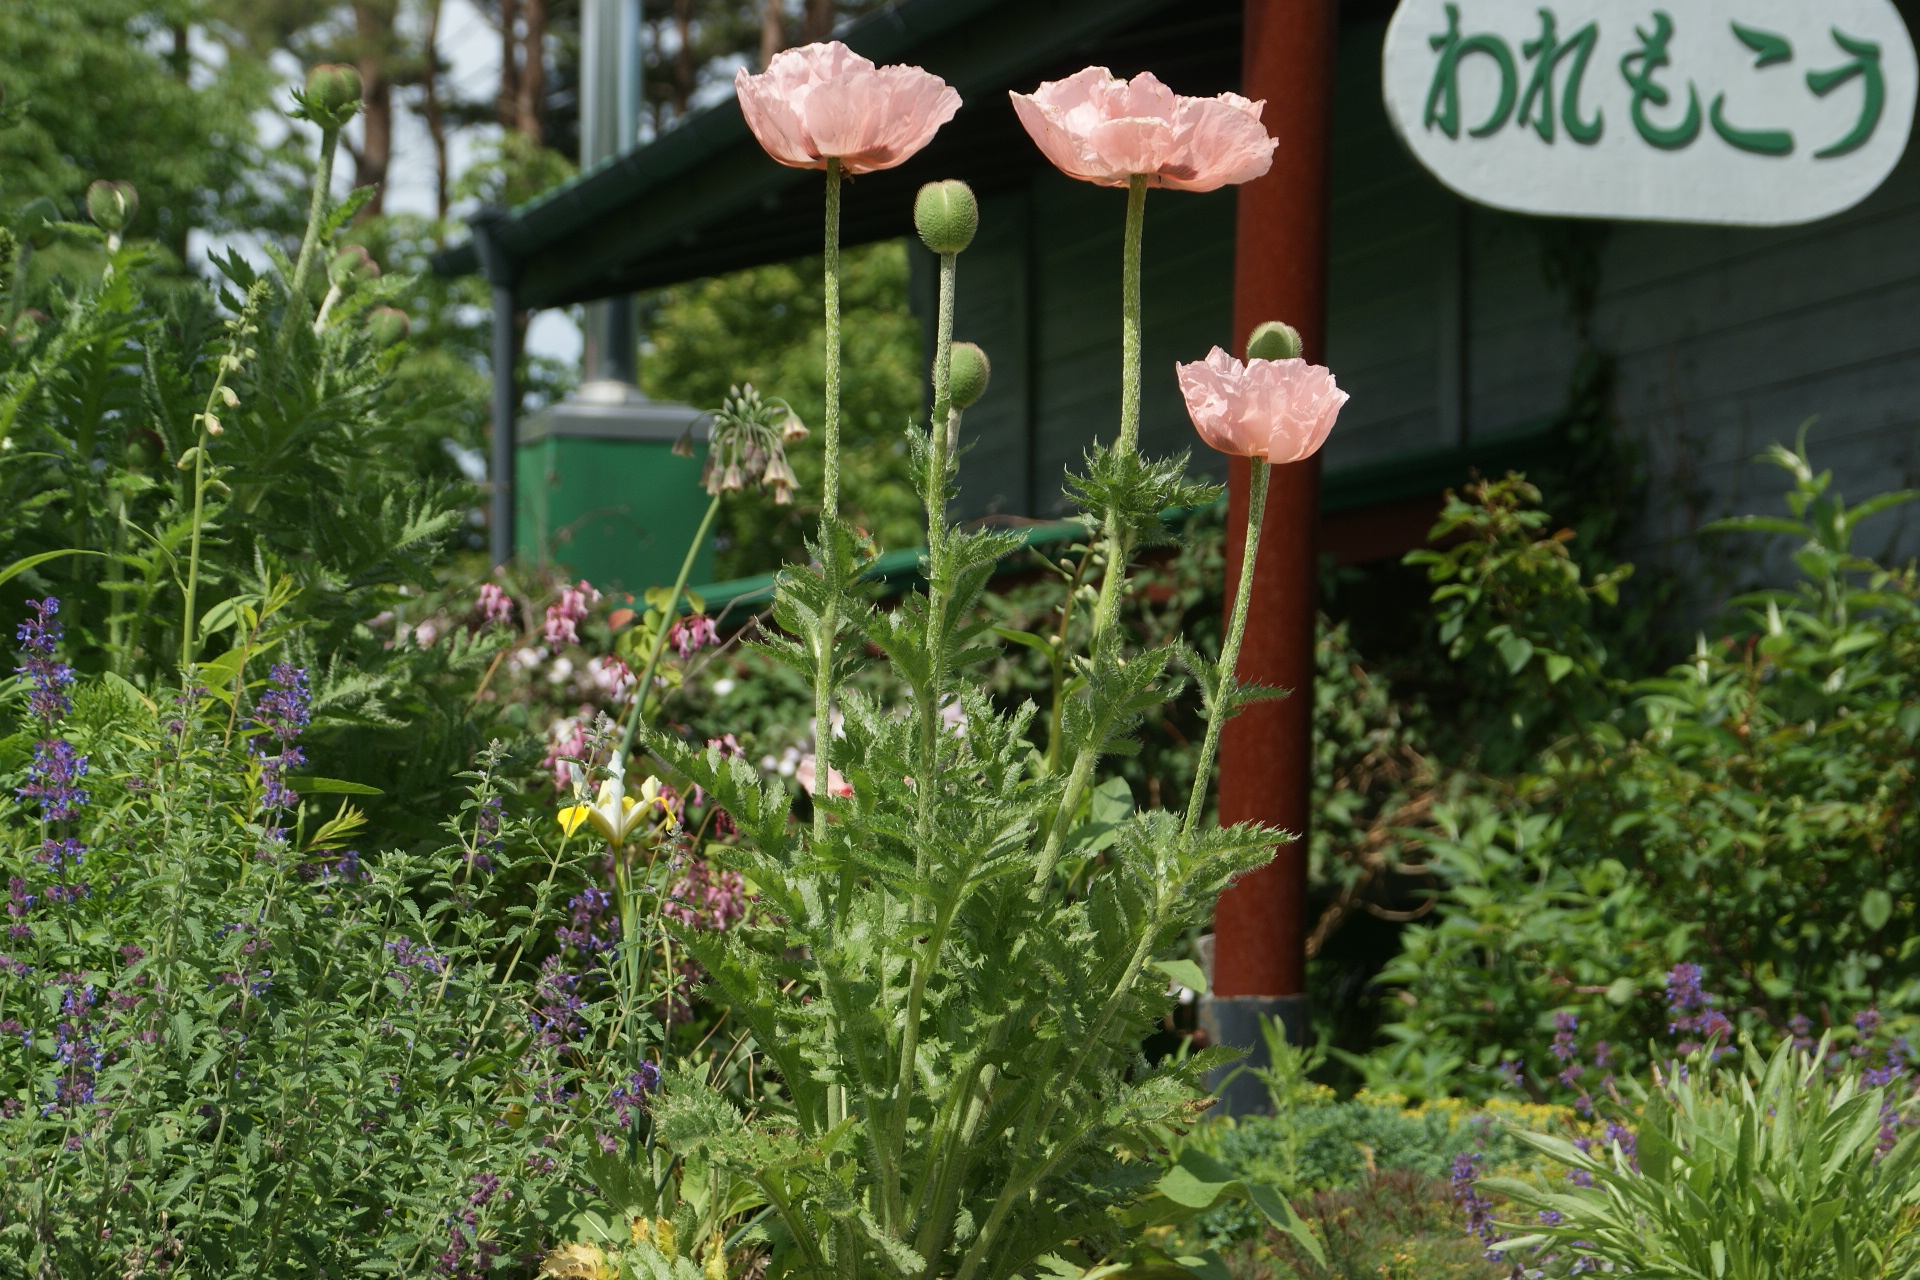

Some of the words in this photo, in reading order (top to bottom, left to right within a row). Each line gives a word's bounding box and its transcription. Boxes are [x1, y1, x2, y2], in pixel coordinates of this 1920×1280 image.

[1424, 2, 1885, 159] われもこう
